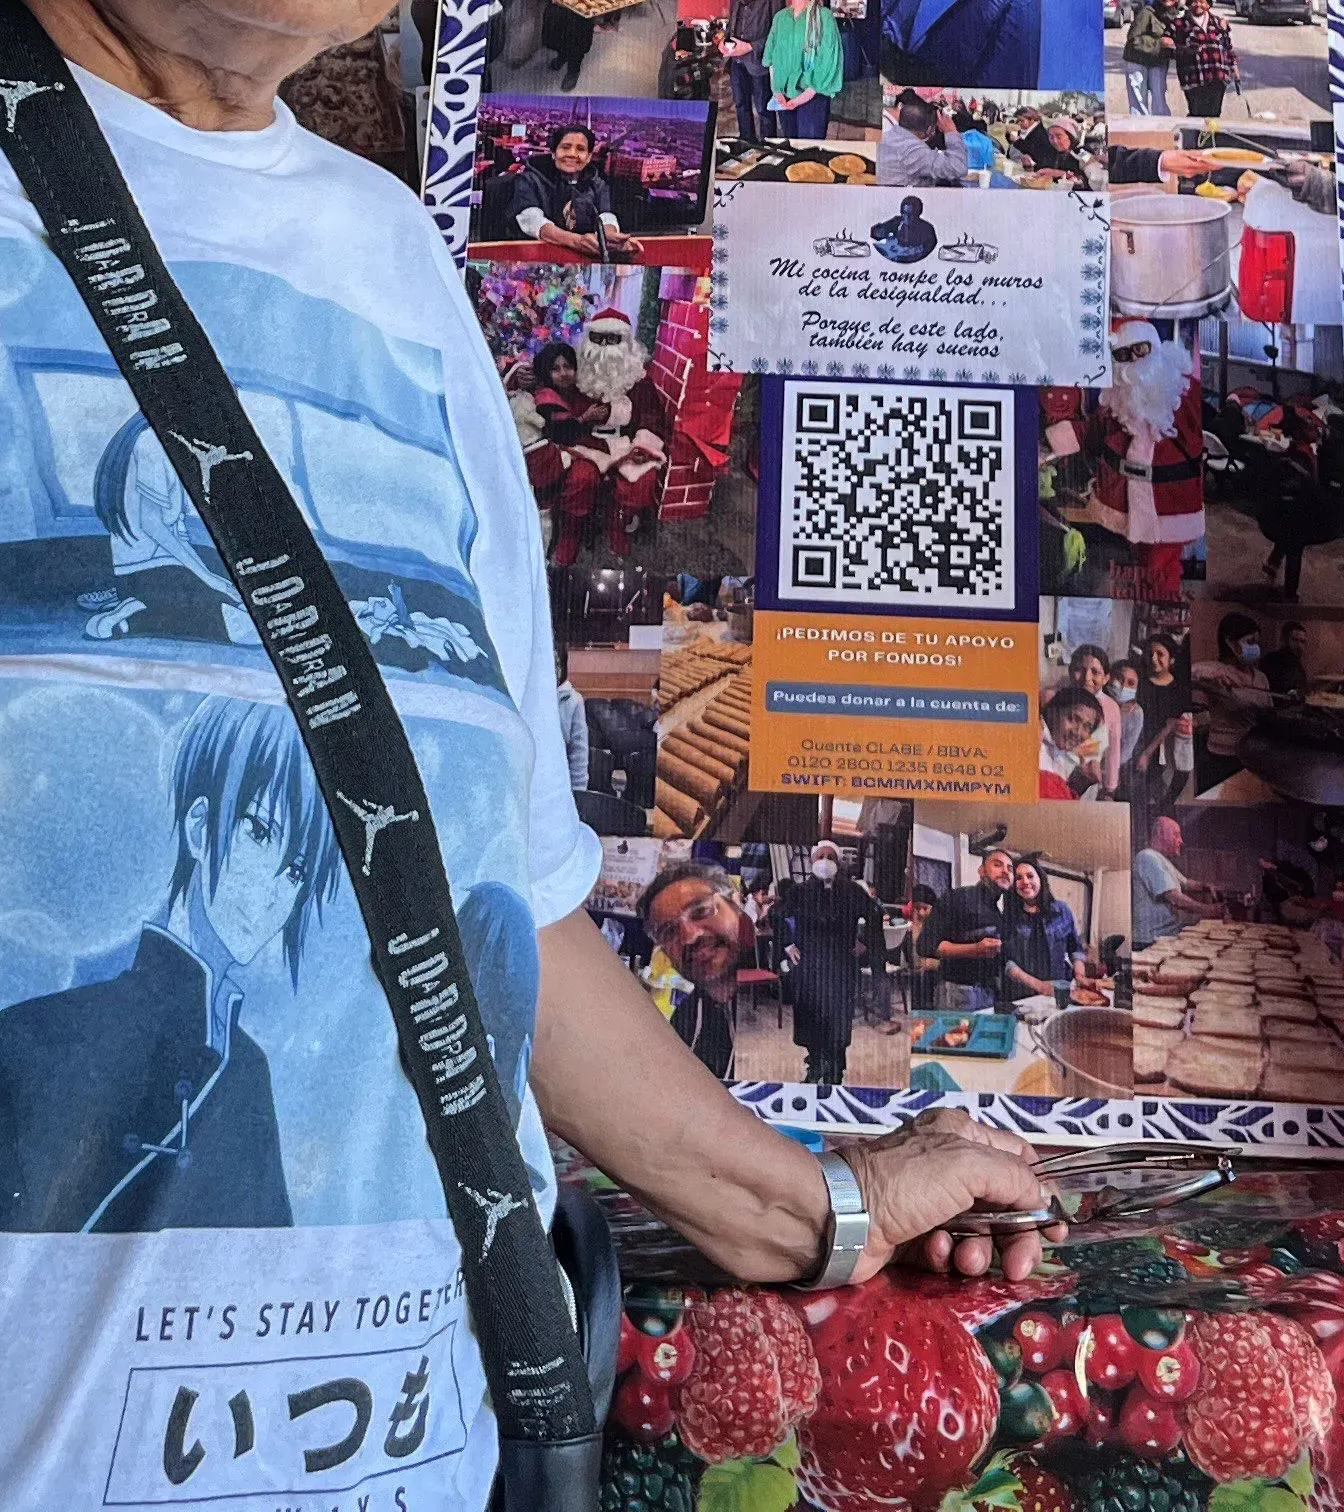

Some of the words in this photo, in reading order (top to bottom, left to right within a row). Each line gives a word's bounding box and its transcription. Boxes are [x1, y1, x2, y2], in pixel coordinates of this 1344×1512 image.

[769, 257, 806, 279] Mi
[812, 264, 871, 284] cocina
[879, 269, 939, 289] rompe
[946, 267, 974, 287] los
[982, 275, 1044, 290] muros
[61, 216, 189, 372] JORDAN
[798, 279, 821, 298] de
[829, 280, 849, 299] la
[801, 310, 871, 338] Porque
[879, 316, 901, 336] de
[908, 320, 946, 338] este
[809, 331, 884, 352] también
[891, 332, 929, 359] hay
[235, 552, 361, 730] JORDAN
[776, 627, 876, 643] ¡PEDIMOS
[882, 631, 907, 644] DE
[914, 633, 938, 646] TU
[945, 634, 1016, 650] APOYO
[828, 649, 868, 662] POR
[874, 651, 963, 667] FONDOS!
[773, 690, 837, 705] Puedes
[841, 692, 891, 708] donar
[896, 699, 906, 708] a
[910, 696, 926, 709] la
[930, 698, 991, 712] cuenta
[995, 700, 1022, 714] de:
[801, 738, 862, 754] Cuenta
[865, 741, 923, 757] CLABE
[780, 772, 846, 788] SWIFT:
[387, 925, 488, 1118] JORDAN
[135, 1303, 238, 1343] LET'S
[256, 1298, 341, 1339] STAY
[164, 1354, 431, 1486] いつも
